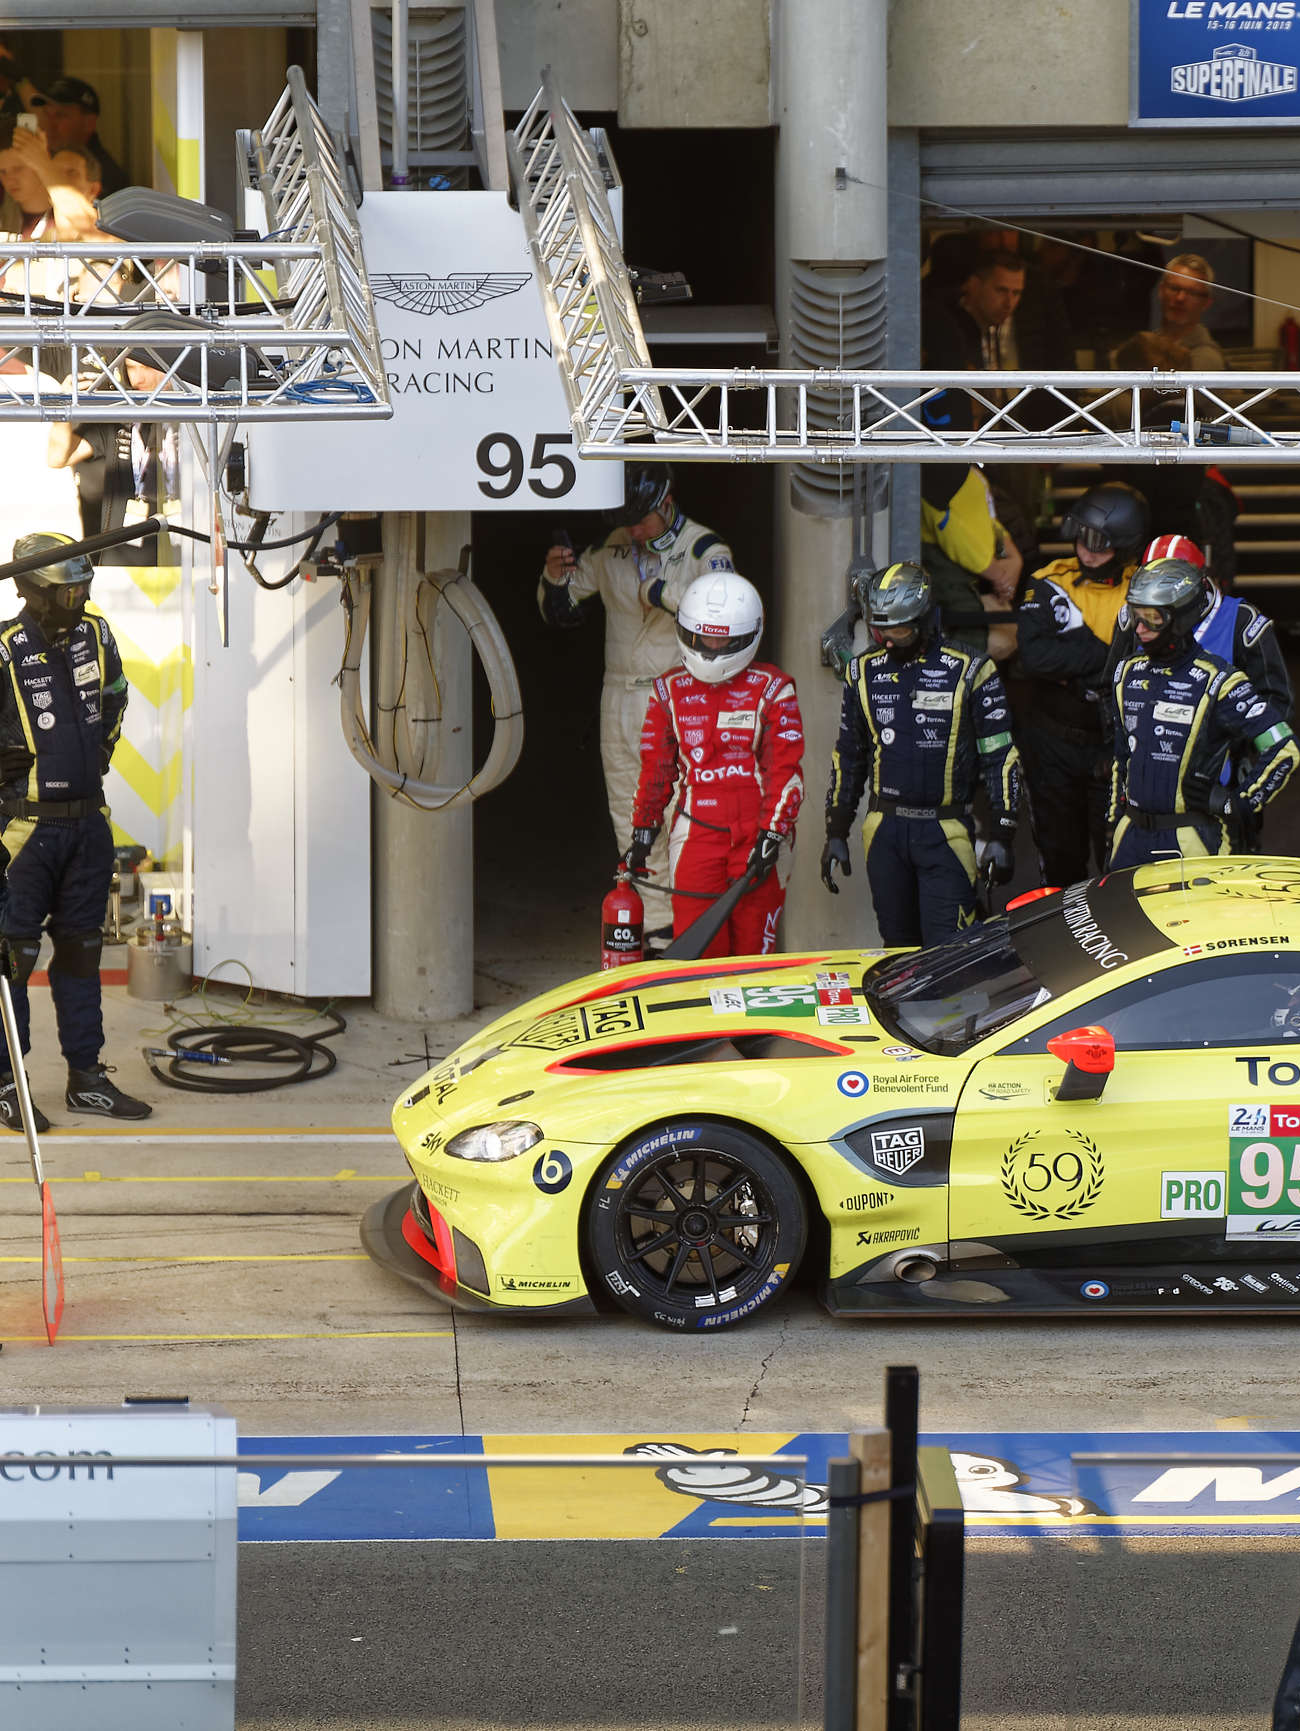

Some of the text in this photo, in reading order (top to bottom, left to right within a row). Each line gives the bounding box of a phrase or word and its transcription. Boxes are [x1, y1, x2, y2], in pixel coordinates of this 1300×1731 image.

[1167, 2, 1297, 18] LE MANS
[1206, 20, 1293, 31] 15-16 JUIN 2019
[1173, 58, 1295, 99] SUPERFINALE
[402, 281, 476, 291] ASTON MARTIN
[437, 337, 554, 359] MARTIN
[386, 371, 495, 394] RACING
[475, 432, 577, 499] 95
[702, 625, 730, 635] TOTAL
[694, 765, 751, 782] TOTAL
[896, 806, 937, 819] sparco
[1071, 922, 1129, 969] RACING
[1205, 935, 1290, 951] SØRENSEN
[745, 983, 816, 1008] 95
[592, 999, 632, 1035] TAG
[825, 1007, 862, 1025] PRO
[873, 1074, 940, 1085] Royal Air Force
[873, 1083, 949, 1093] Benevolent Fund
[626, 1129, 695, 1168] MICHELIN
[875, 1131, 920, 1150] TAG
[877, 1148, 921, 1171] HEUER
[1022, 1152, 1083, 1192] 59
[422, 1173, 461, 1203] HACKETT
[1166, 1179, 1222, 1211] PRO
[846, 1192, 889, 1211] DUPONT
[518, 1280, 571, 1288] MICHELIN
[705, 1284, 772, 1327] MICHELIN
